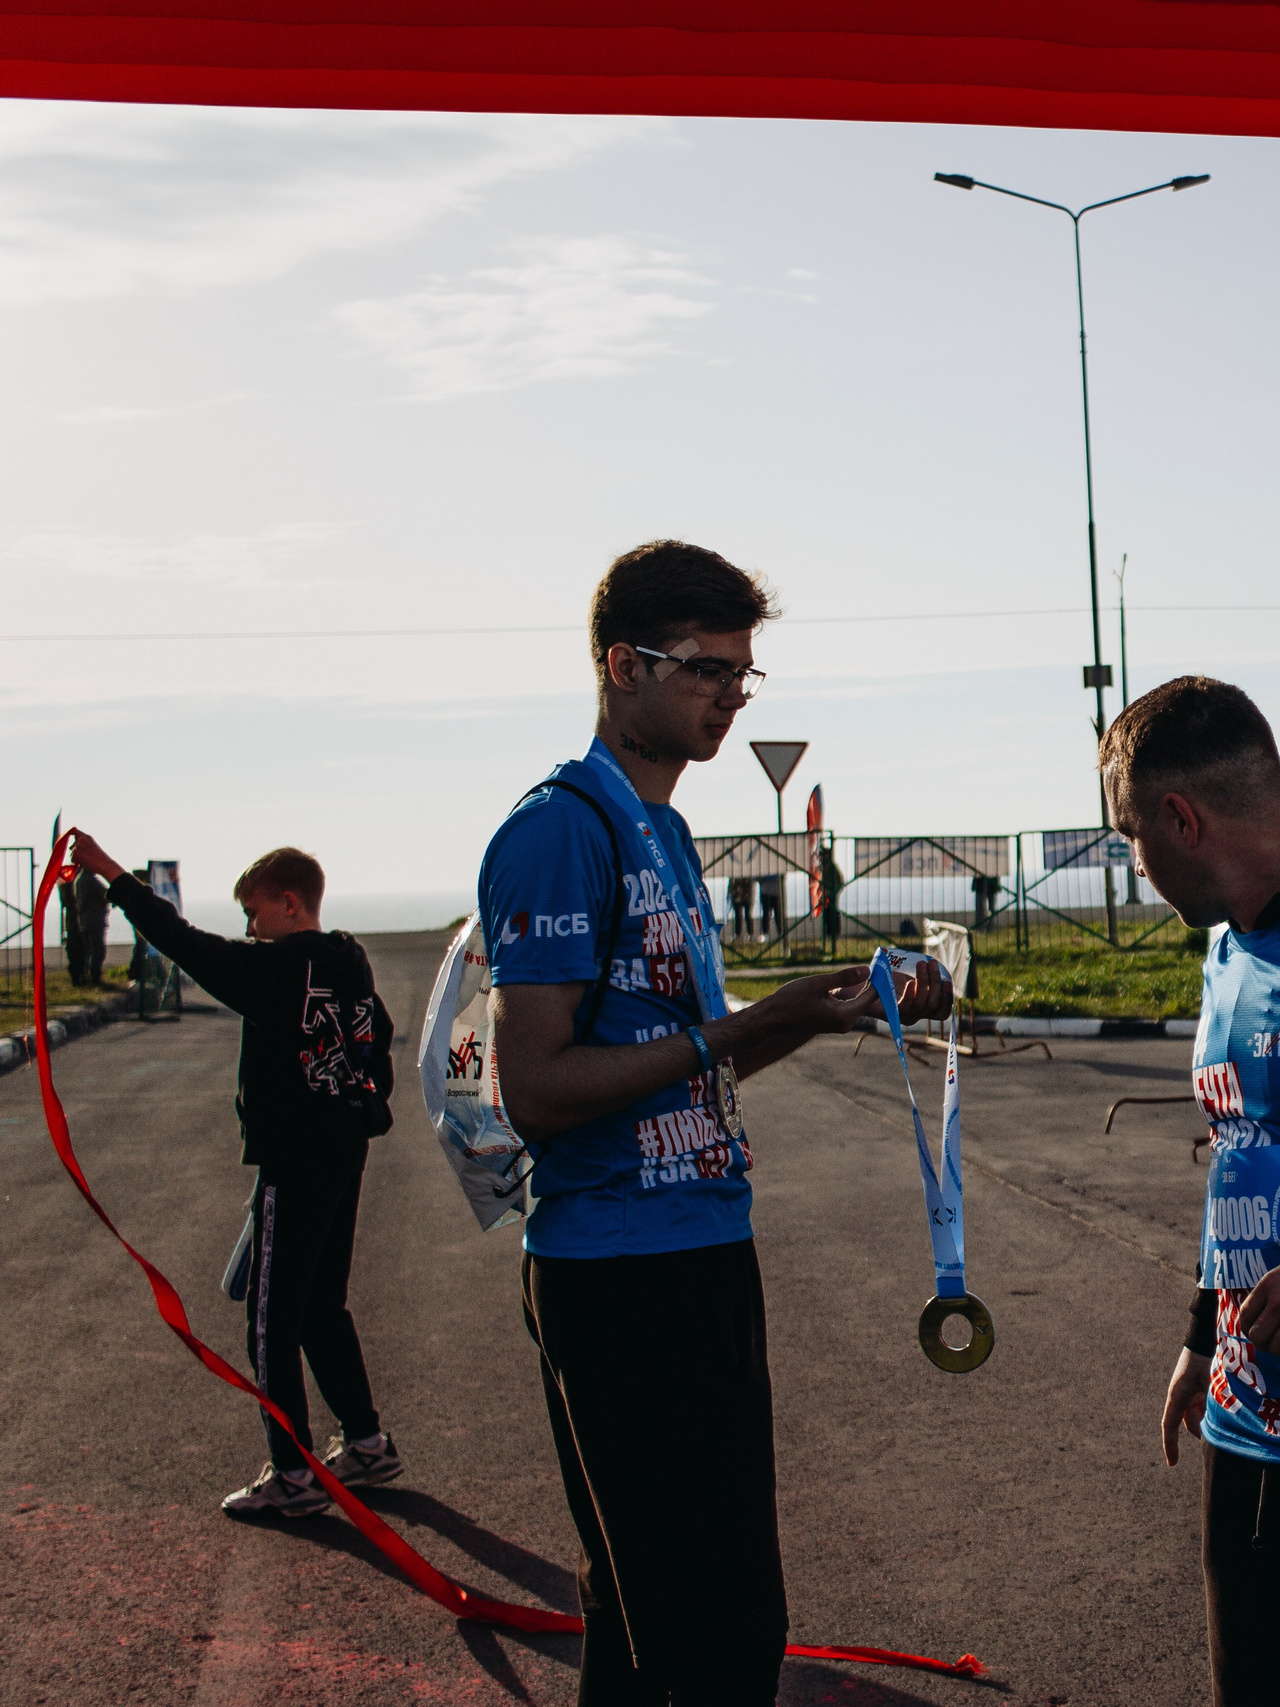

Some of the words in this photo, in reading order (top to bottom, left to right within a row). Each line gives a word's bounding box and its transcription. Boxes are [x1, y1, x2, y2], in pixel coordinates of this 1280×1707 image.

[647, 839, 666, 868] ПСБ
[623, 868, 670, 917] 202
[534, 912, 590, 938] ПСБ
[634, 1102, 727, 1158] #ЛЮБО
[1210, 1196, 1271, 1242] 40006
